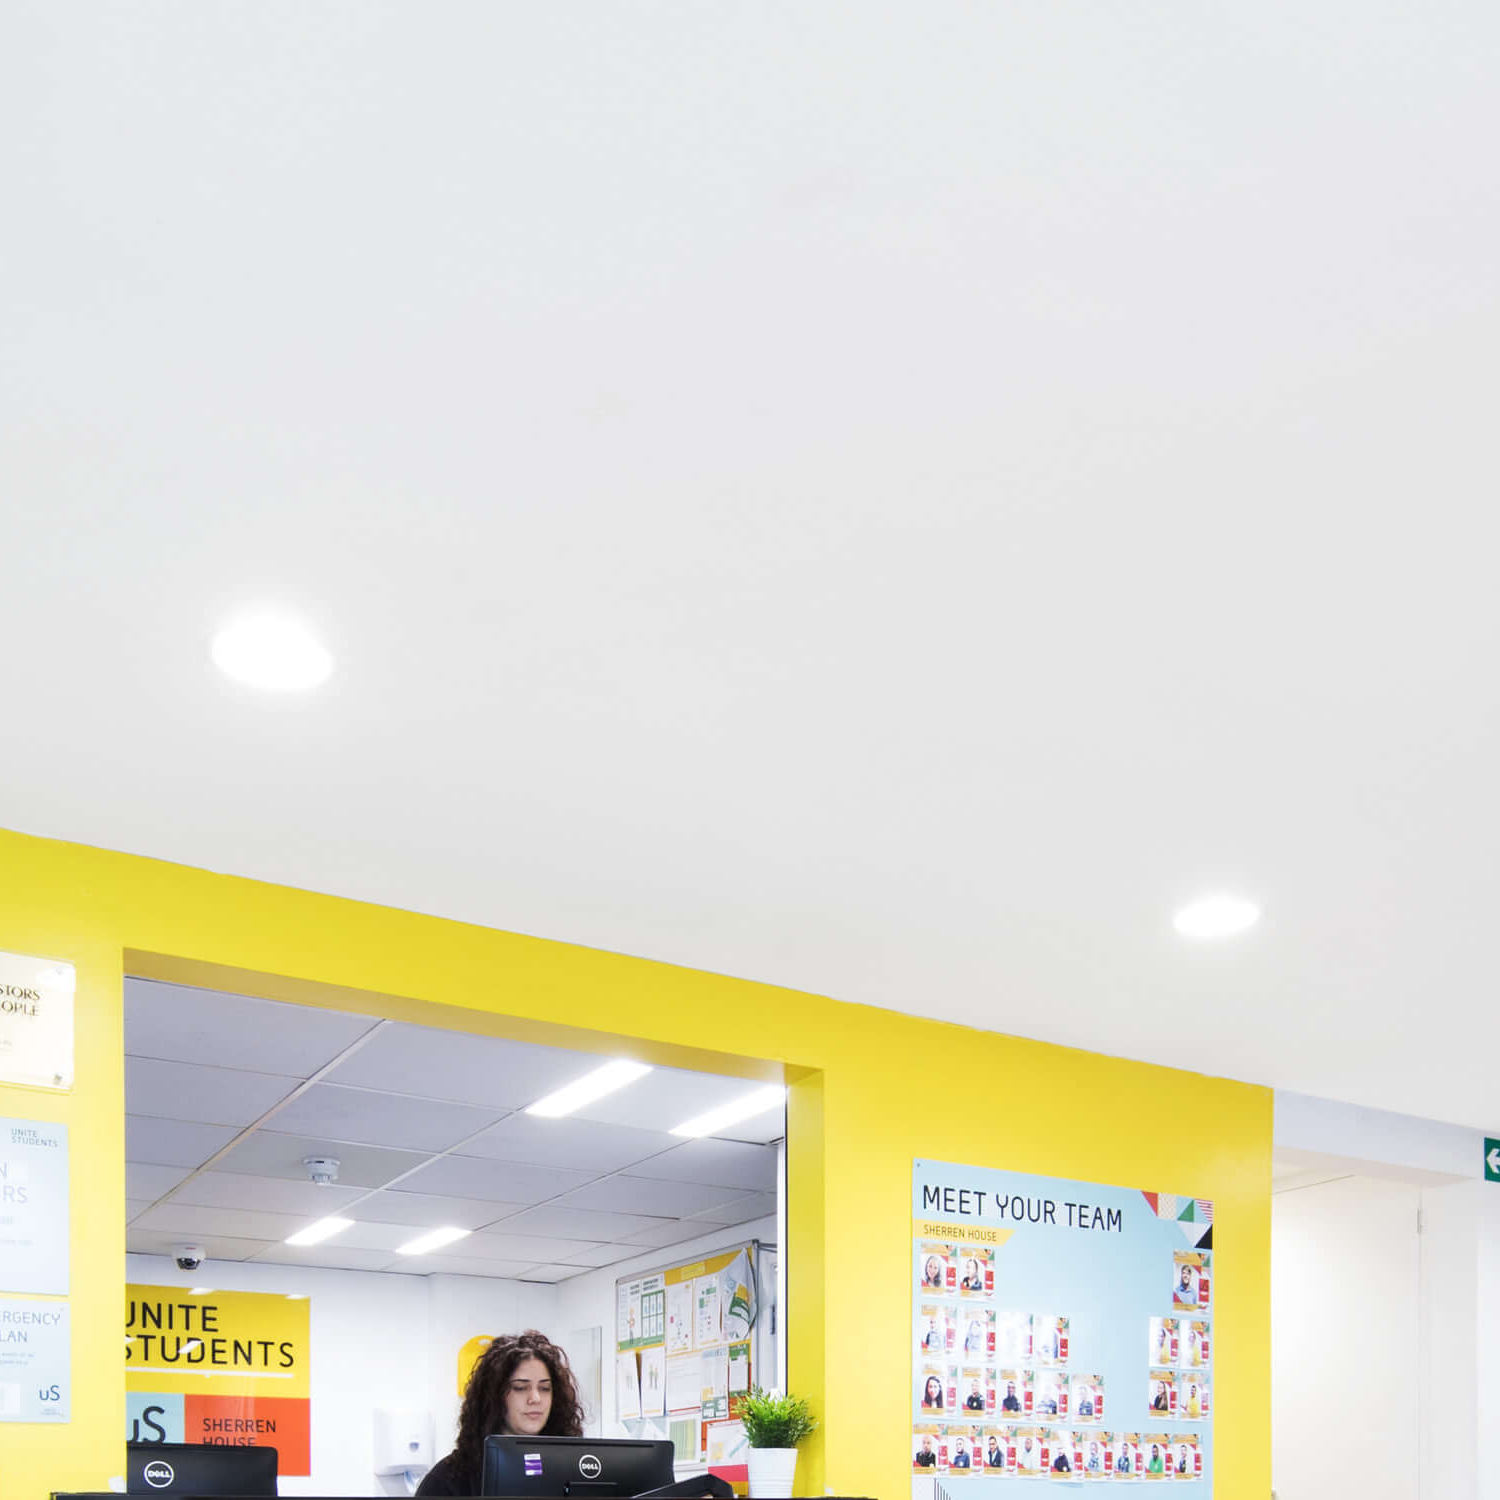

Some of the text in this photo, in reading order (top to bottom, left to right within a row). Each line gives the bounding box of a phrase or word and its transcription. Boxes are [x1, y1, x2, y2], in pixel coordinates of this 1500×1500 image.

[11, 1128, 38, 1138] UNITE
[11, 1135, 59, 1148] STUDENTS
[923, 1184, 1122, 1233] MEET YOUR TEAM
[923, 1224, 997, 1242] SHERREN HOUSE
[38, 1384, 61, 1401] uS
[202, 1417, 277, 1433] SHERREN
[147, 1469, 172, 1478] DELL
